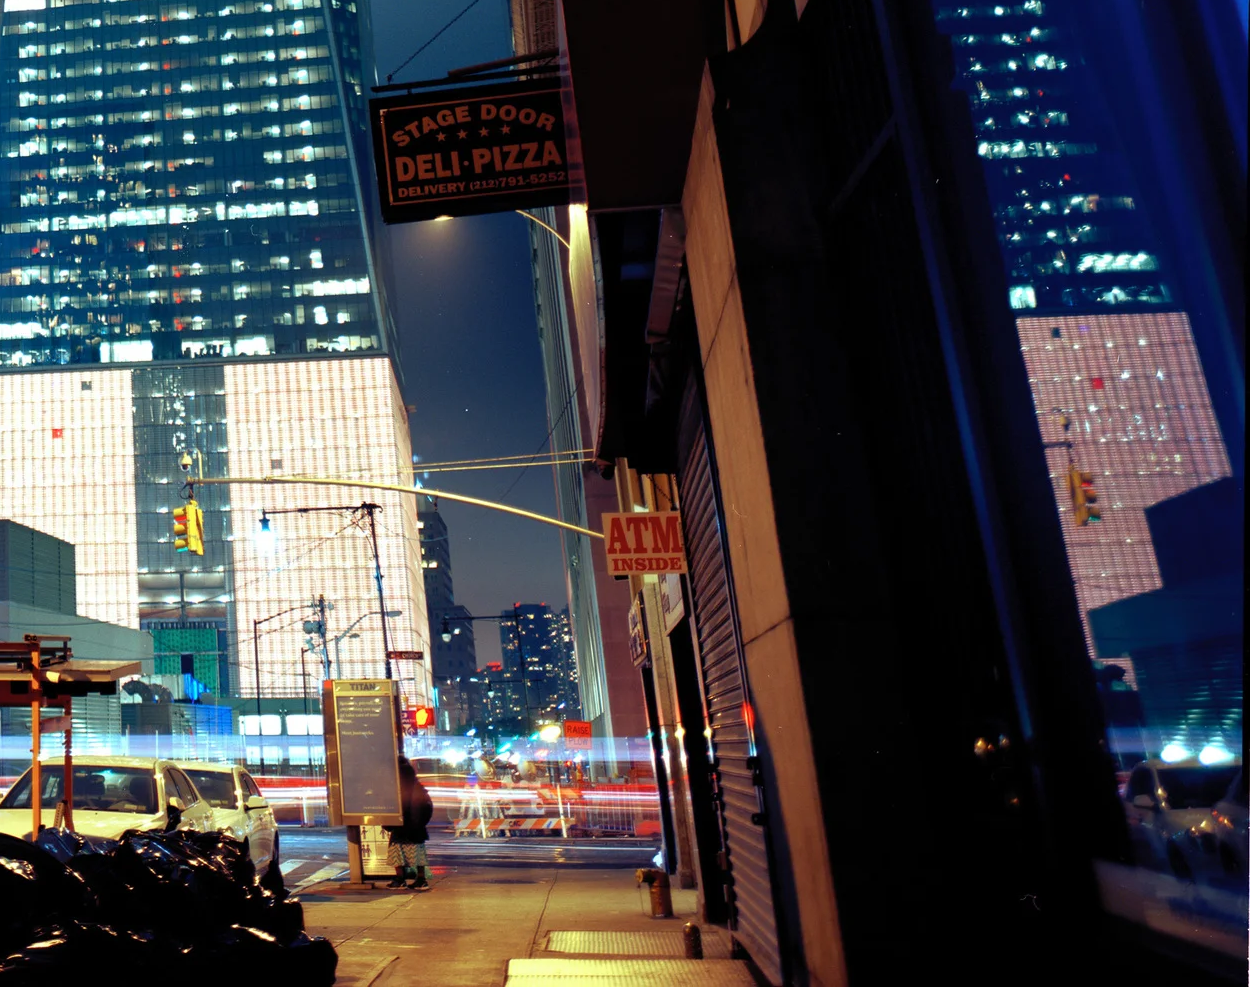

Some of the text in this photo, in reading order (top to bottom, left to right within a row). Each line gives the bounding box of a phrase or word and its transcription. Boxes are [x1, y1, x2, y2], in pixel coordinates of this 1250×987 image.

[392, 104, 556, 147] STAGE DOOR
[398, 181, 466, 198] DELIVERY
[608, 516, 683, 554] ATM
[612, 557, 682, 571] INSIDE
[349, 683, 376, 691] TITAN
[566, 724, 590, 735] RAISE
[568, 737, 588, 746] PLOW
